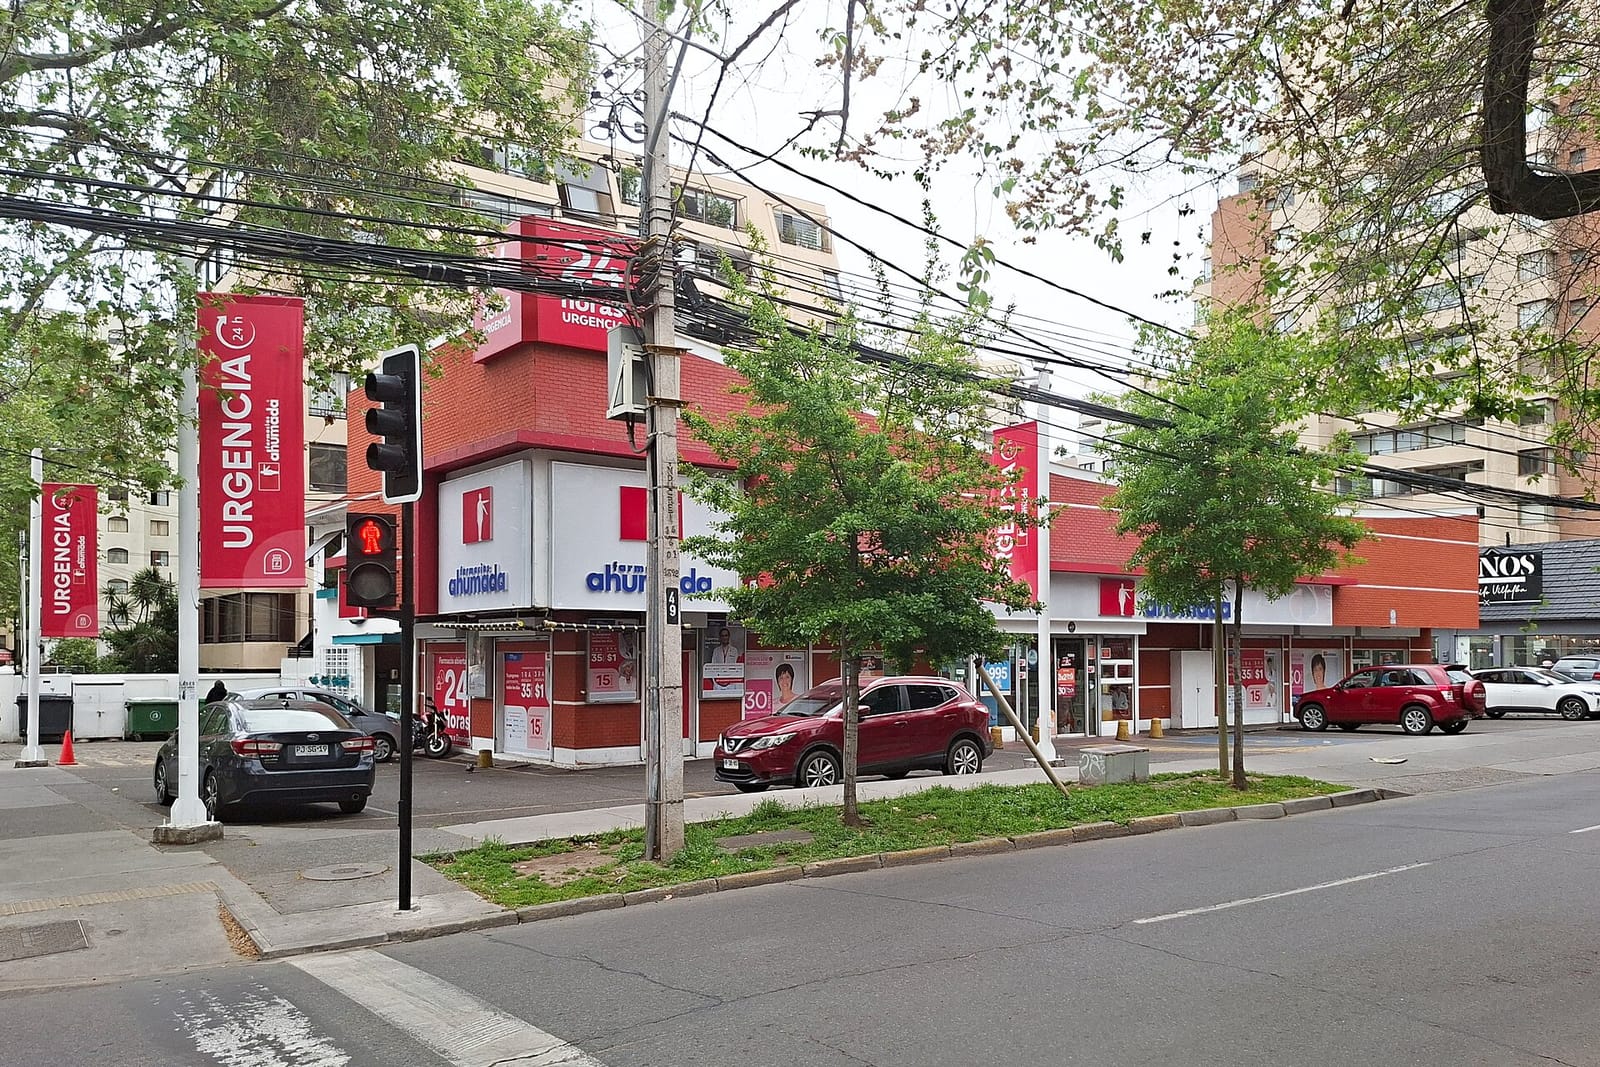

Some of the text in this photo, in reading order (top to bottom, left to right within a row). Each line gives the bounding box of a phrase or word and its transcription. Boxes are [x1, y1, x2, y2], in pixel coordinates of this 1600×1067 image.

[560, 242, 624, 287] 24
[232, 316, 243, 341] 24 h
[265, 399, 280, 461] ahumada
[221, 355, 254, 548] URGENCIA
[54, 512, 71, 615] URGENCIA
[448, 564, 505, 595] ahumada
[586, 564, 712, 594] ahuda
[668, 591, 677, 617] 49
[591, 653, 603, 662] 35
[596, 674, 611, 686] 15
[1241, 668, 1264, 680] 35 $1
[444, 668, 469, 708] 24
[521, 682, 544, 699] 35 $1
[745, 690, 768, 710] 30
[1249, 690, 1261, 702] 15
[530, 718, 541, 735] 15
